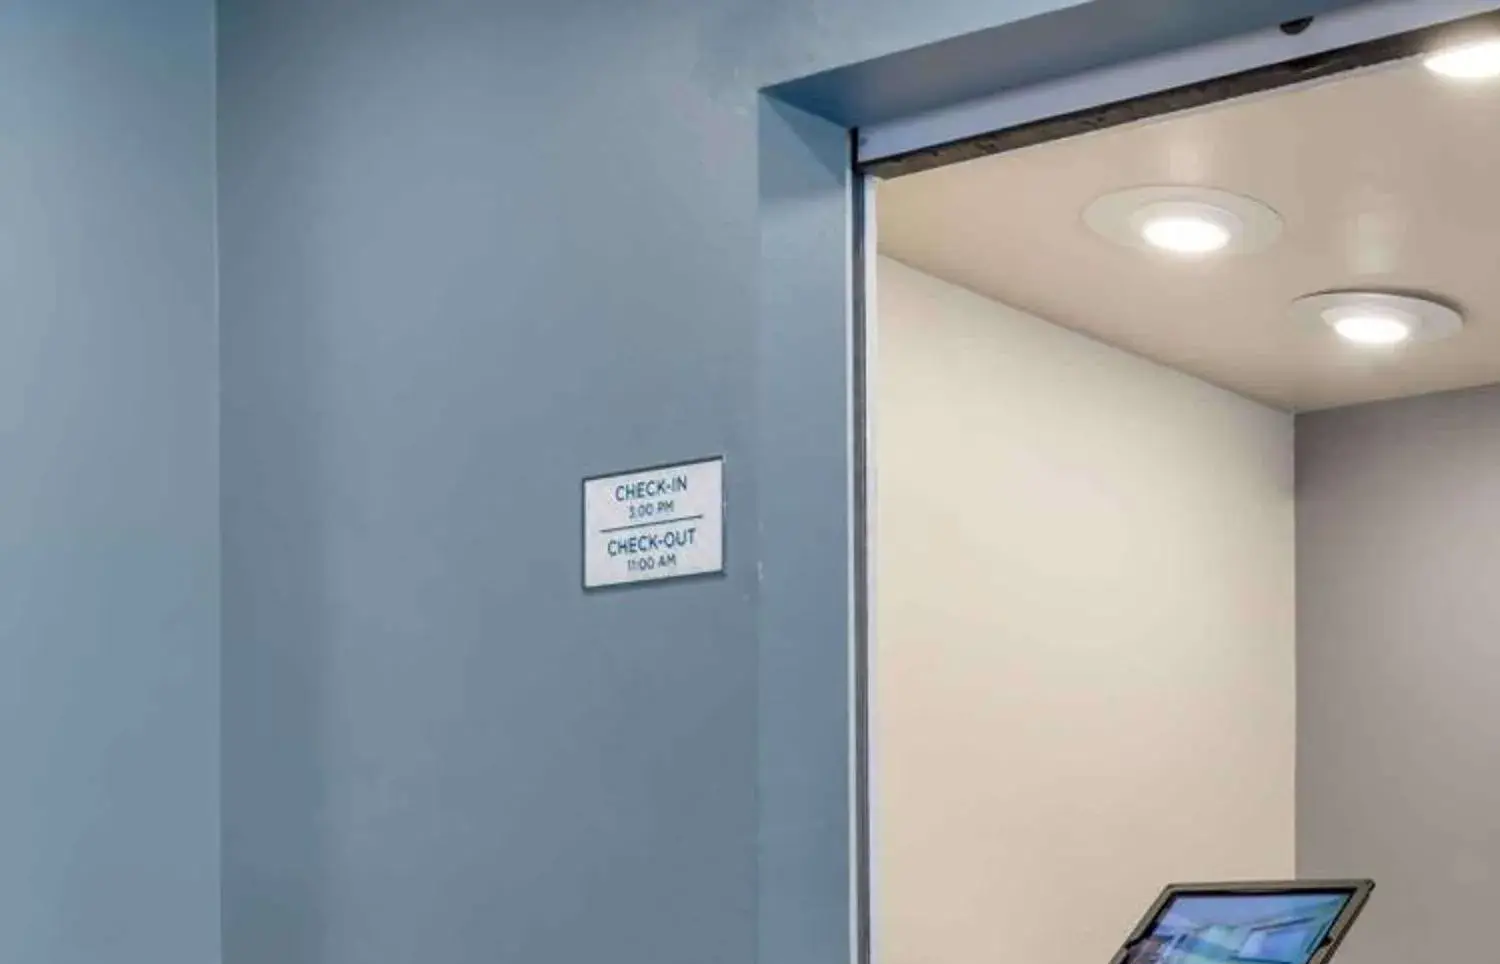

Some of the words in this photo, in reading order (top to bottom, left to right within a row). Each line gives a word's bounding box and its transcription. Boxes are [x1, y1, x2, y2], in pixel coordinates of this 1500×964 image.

[615, 475, 687, 501] CHECK-IN
[657, 500, 674, 512] PM
[607, 529, 696, 556] CHECK-OUT
[627, 556, 655, 572] 11:00
[658, 553, 677, 568] AM
